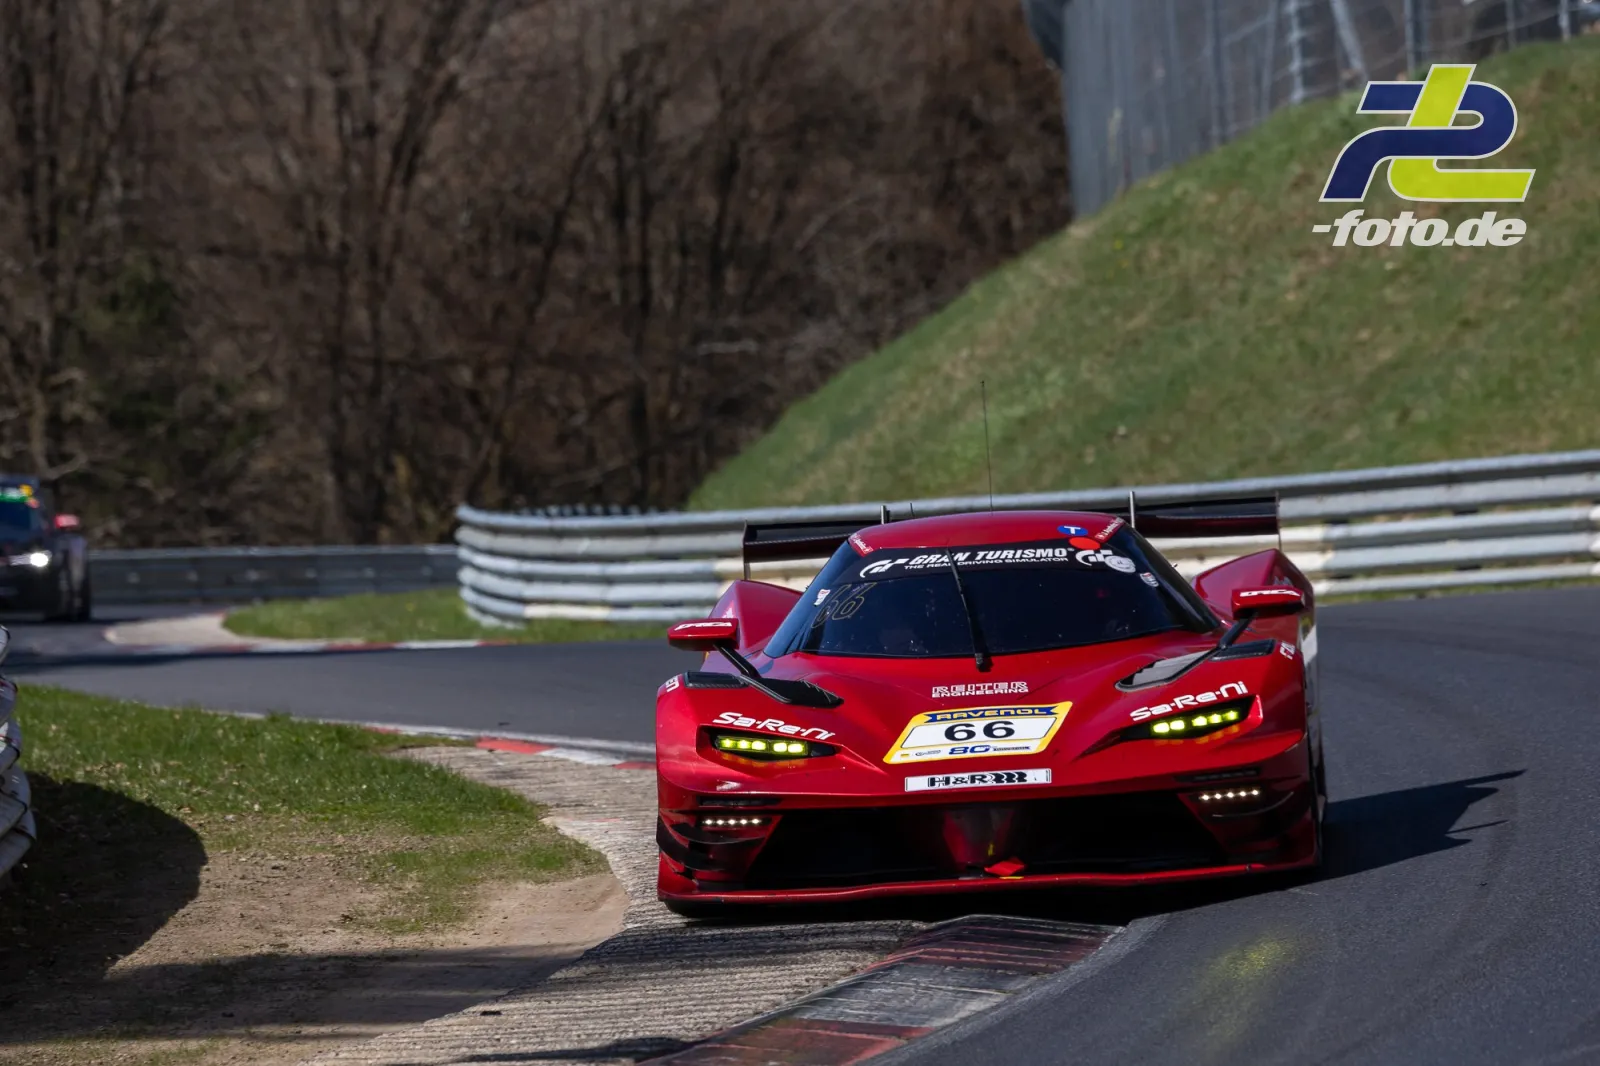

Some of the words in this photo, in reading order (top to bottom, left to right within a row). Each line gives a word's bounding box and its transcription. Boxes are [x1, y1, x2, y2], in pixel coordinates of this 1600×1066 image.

[909, 552, 971, 565] GRAN
[975, 547, 1067, 561] TURISMO
[931, 688, 1029, 698] ENGINEERING
[932, 681, 1028, 694] REITER
[936, 709, 1047, 721] RAVENOL
[944, 721, 1015, 741] 66
